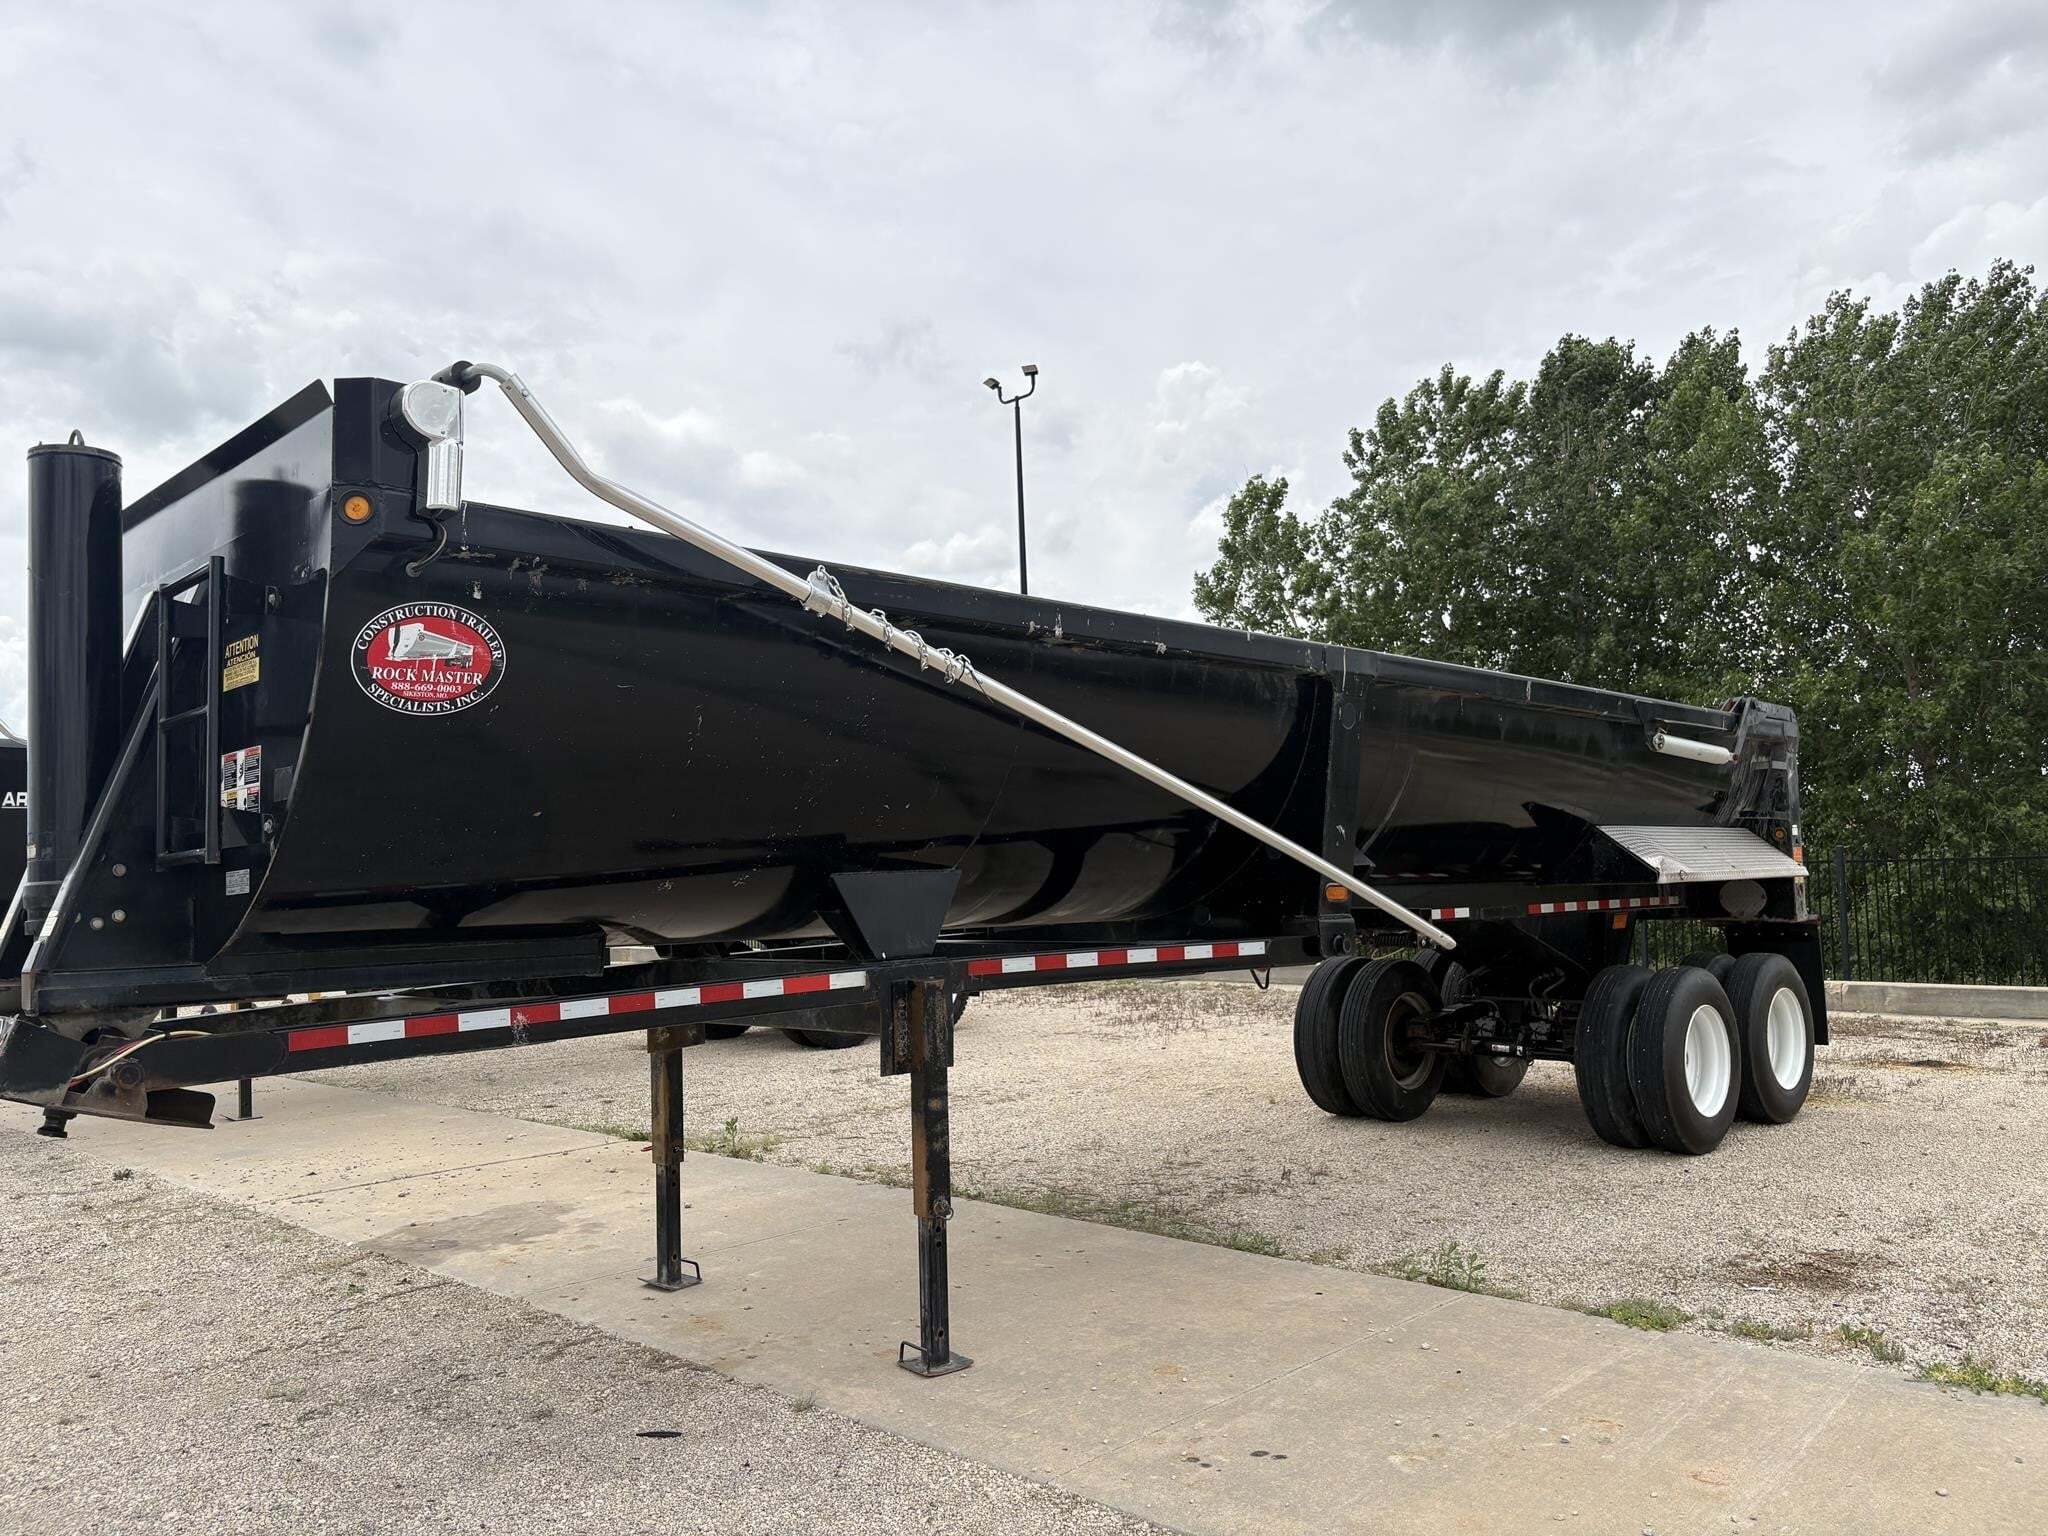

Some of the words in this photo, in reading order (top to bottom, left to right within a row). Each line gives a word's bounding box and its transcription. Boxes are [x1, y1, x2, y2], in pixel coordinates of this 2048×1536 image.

[357, 605, 457, 650] CONSTRUCTION
[460, 612, 502, 659] TRAILER
[225, 633, 259, 659] ATTENTION
[372, 666, 418, 681] ROCK
[421, 669, 483, 686] MASTER
[390, 682, 462, 693] 888-669-0003
[367, 683, 455, 712] SPECIALISTS,
[457, 689, 484, 708] INC.
